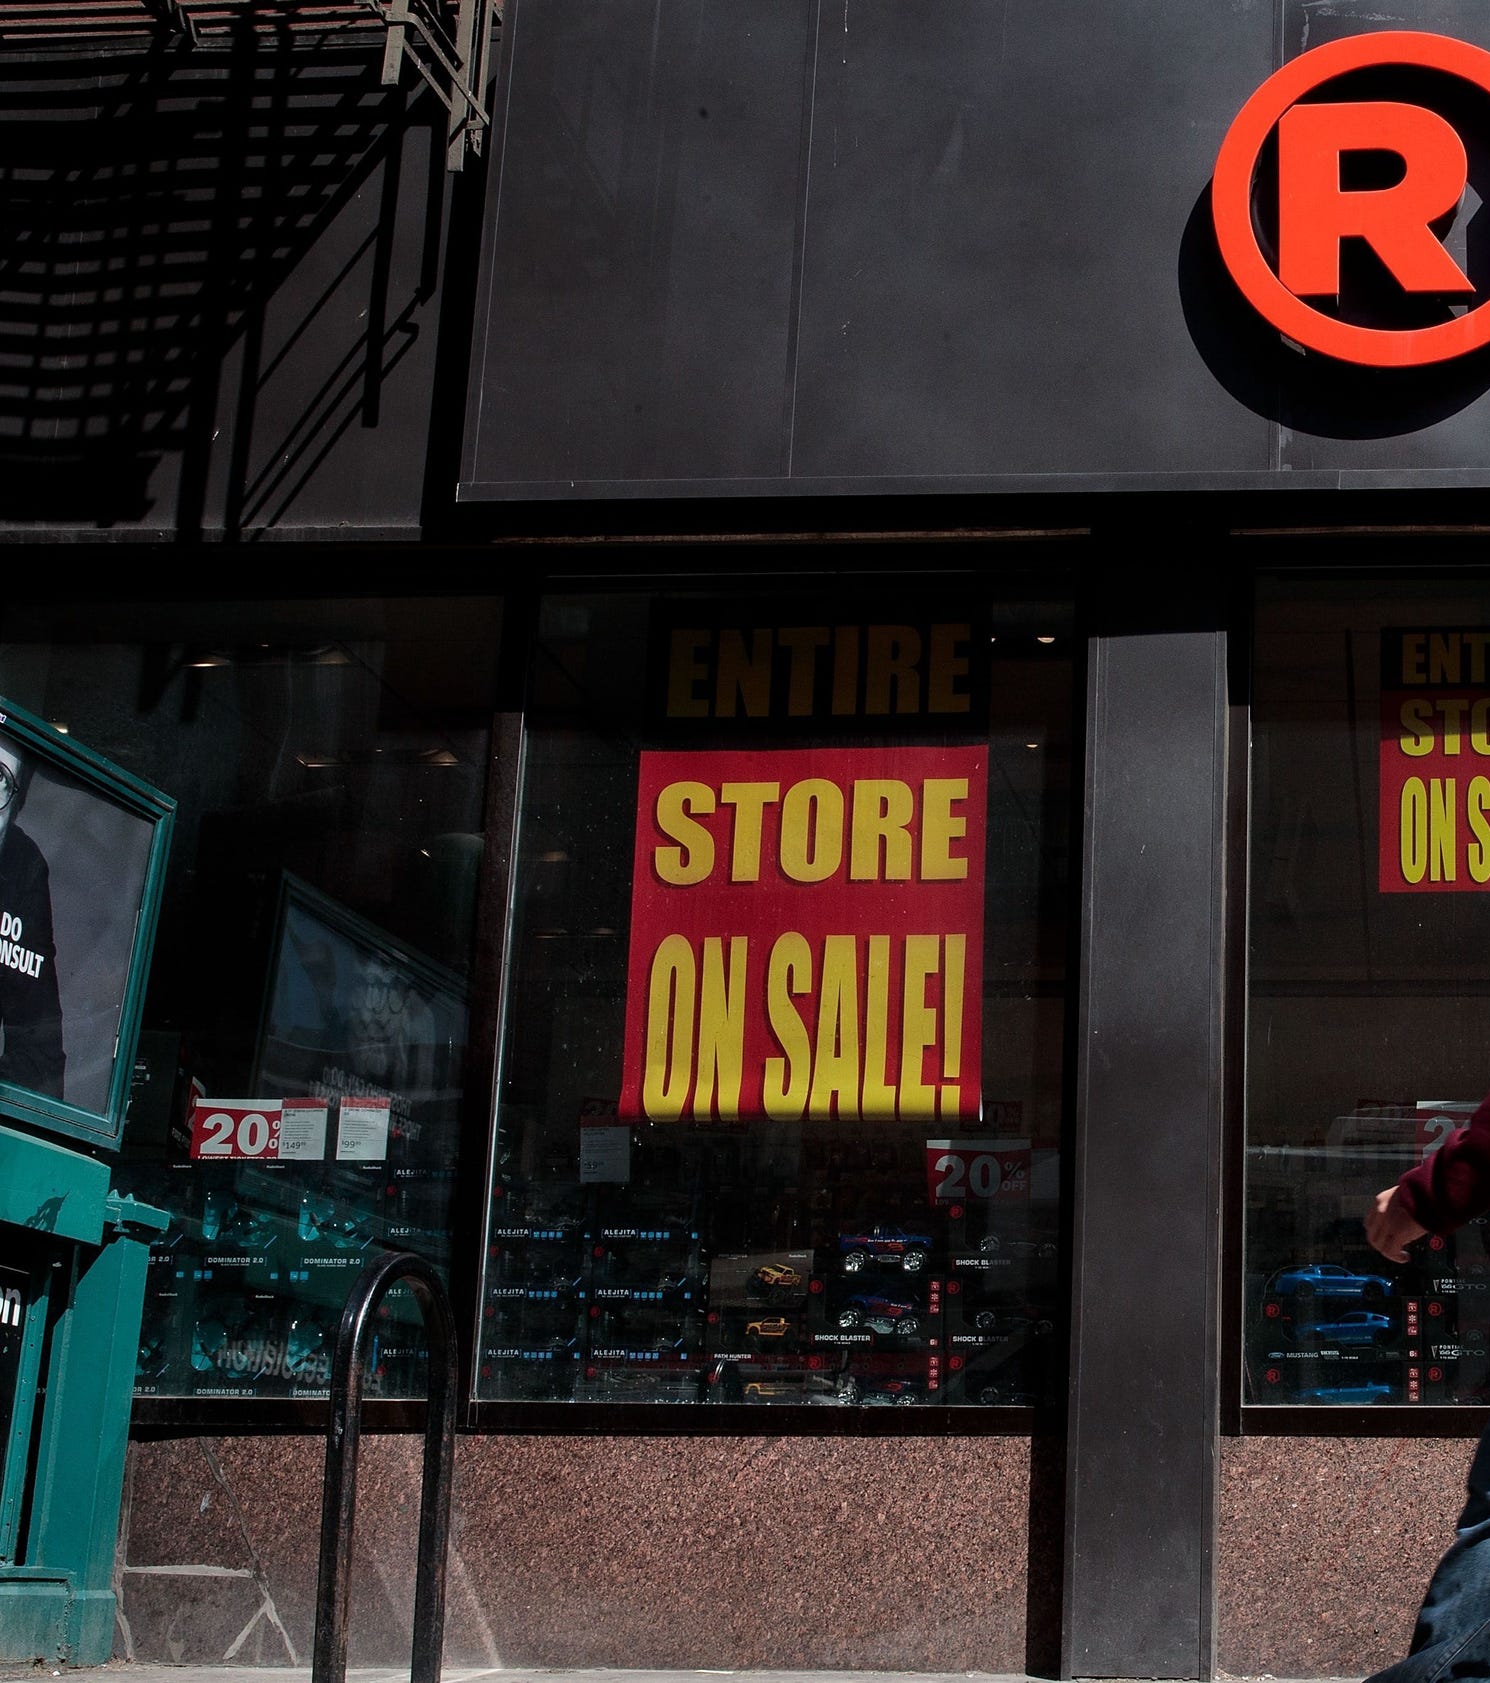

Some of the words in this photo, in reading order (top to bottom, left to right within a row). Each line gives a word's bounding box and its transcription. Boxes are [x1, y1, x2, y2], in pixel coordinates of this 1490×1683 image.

[666, 624, 972, 718] ENTIRE
[654, 778, 970, 886] STORE
[1400, 776, 1456, 884] ON
[0, 911, 23, 942] DO
[642, 933, 749, 1122] ON
[763, 931, 967, 1122] SALE!
[497, 1228, 530, 1236] ALEJITA
[603, 1229, 637, 1237] ALEJITA
[207, 1256, 250, 1264] DOMINATOR
[303, 1257, 347, 1265] DOMINATOR
[597, 1289, 630, 1297] ALEJITA
[814, 1334, 839, 1342] SHOCK
[840, 1334, 871, 1342] BLASTER
[593, 1349, 626, 1357] ALEJITA
